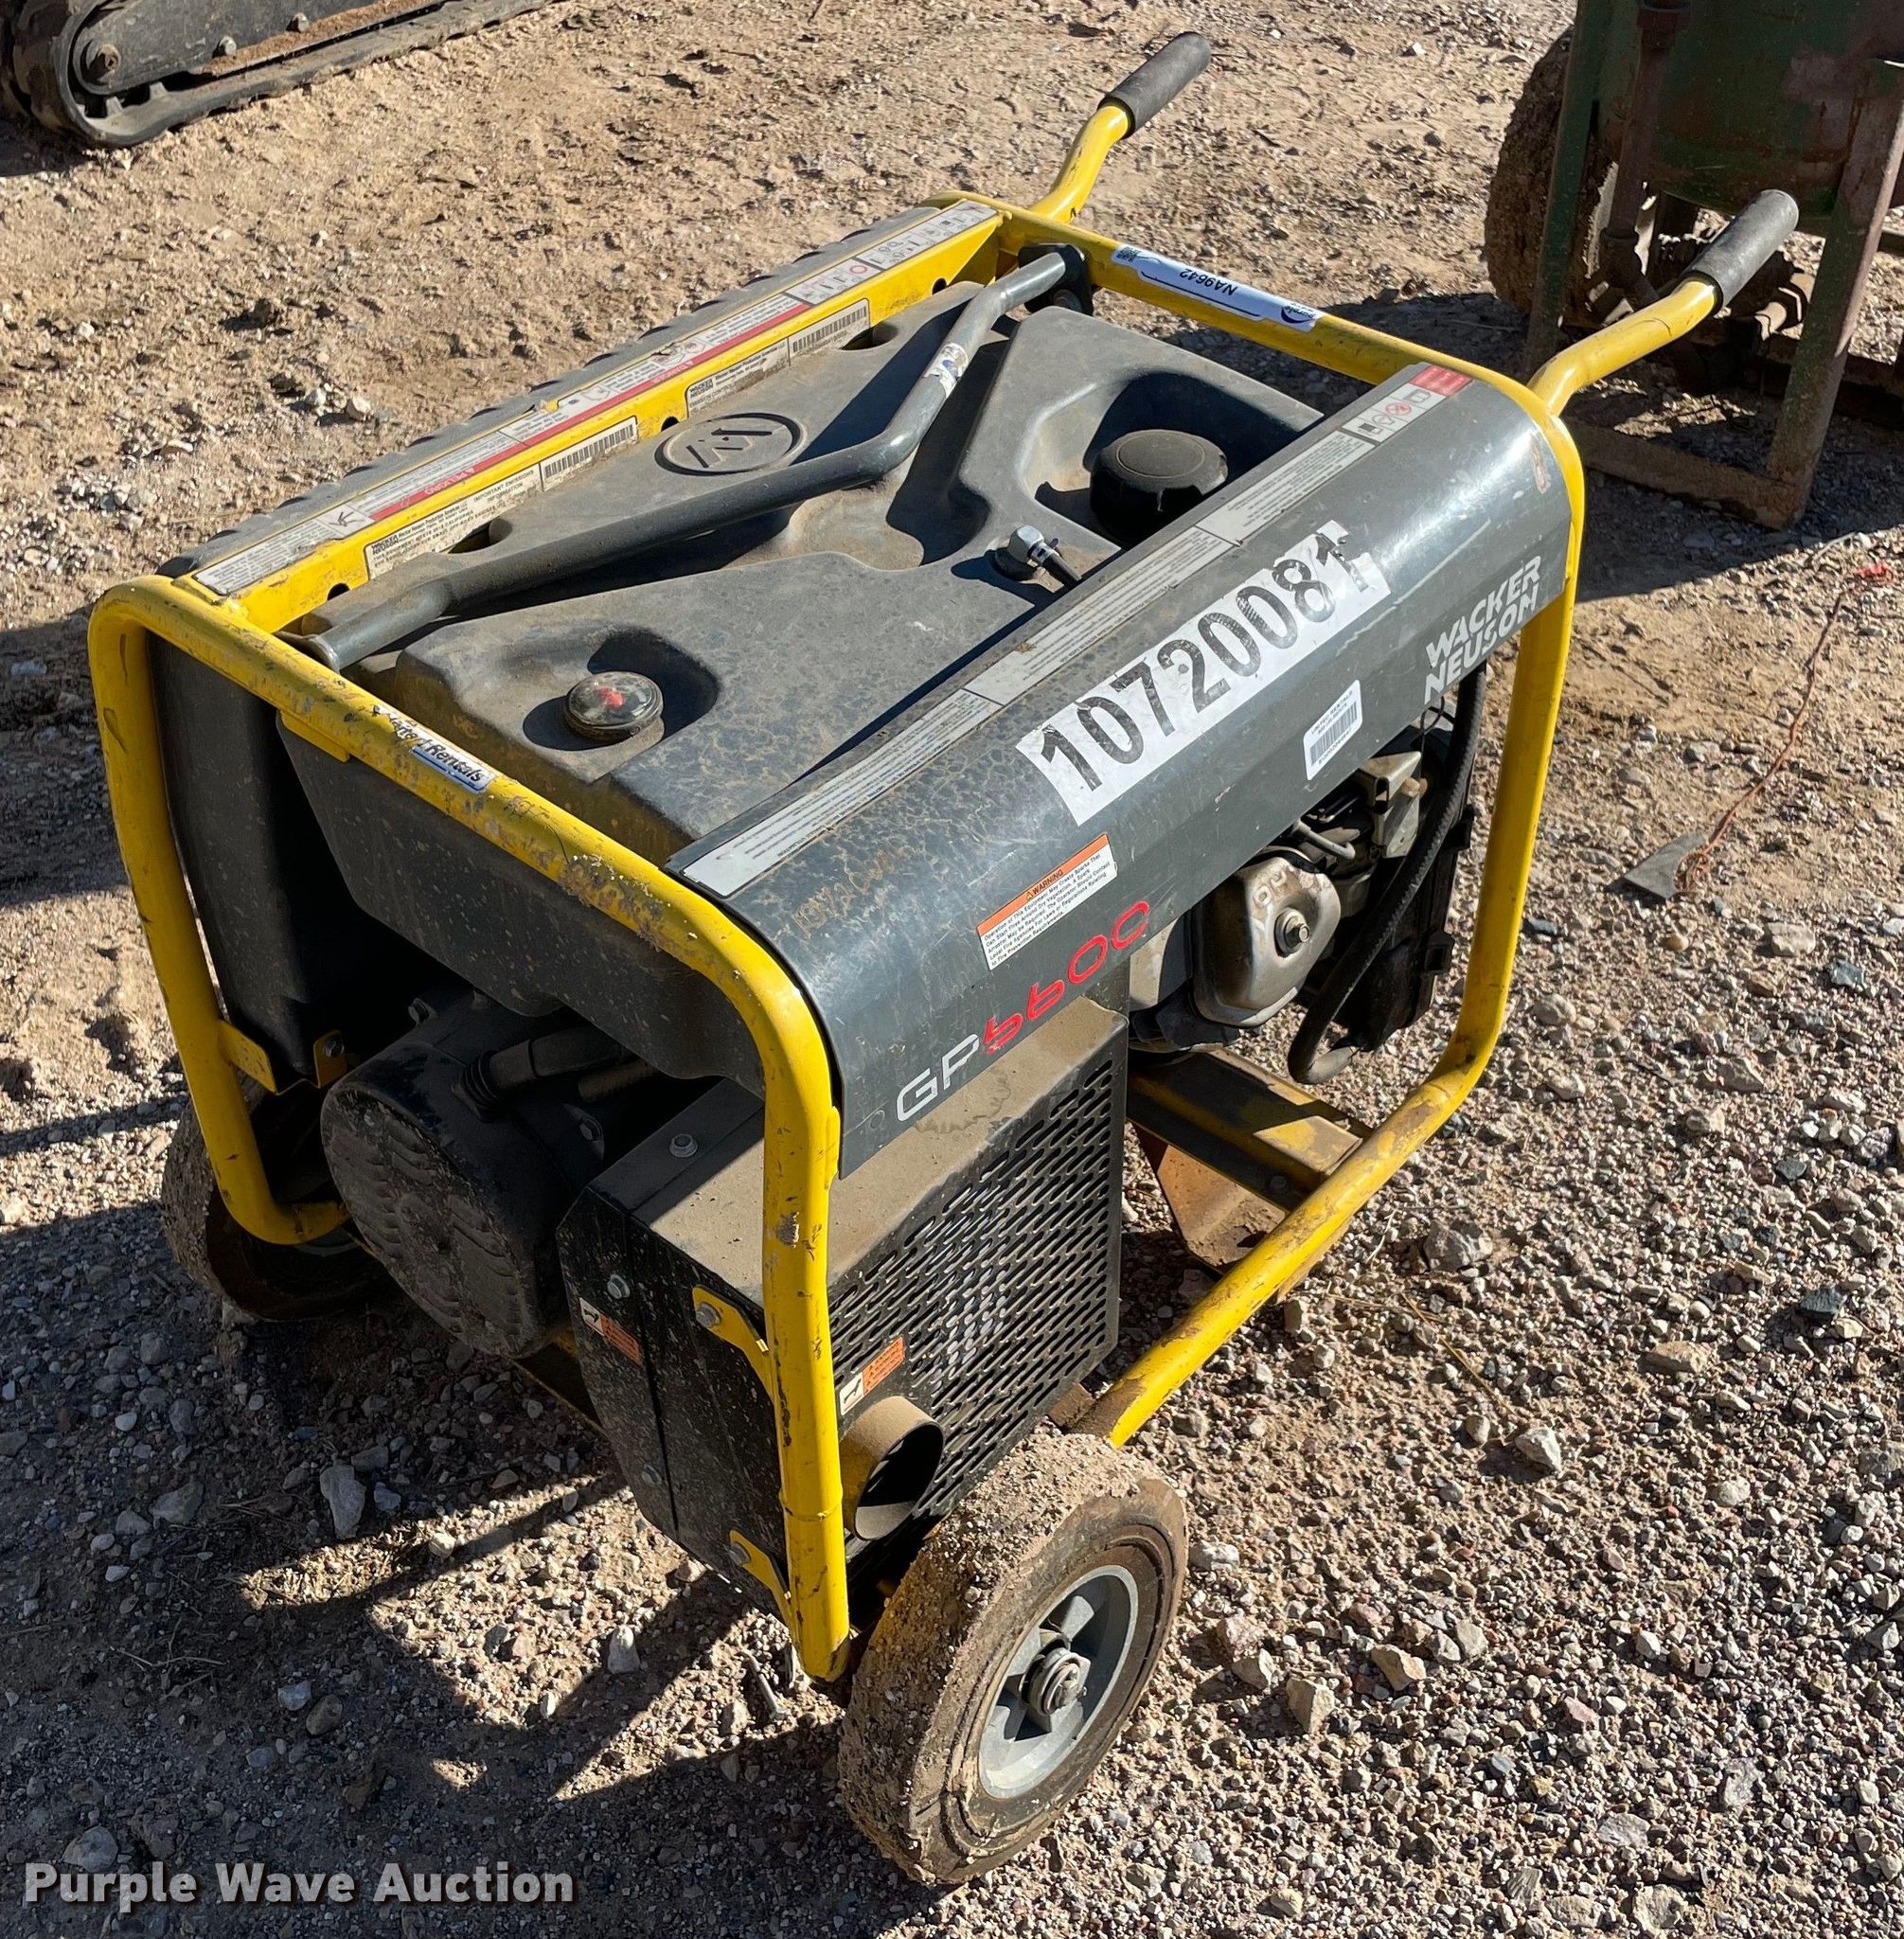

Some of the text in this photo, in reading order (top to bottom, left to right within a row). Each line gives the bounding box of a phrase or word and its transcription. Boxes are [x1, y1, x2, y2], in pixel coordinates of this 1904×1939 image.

[1179, 268, 1237, 296] NA9642
[1424, 582, 1539, 704] NEUSON
[1425, 555, 1541, 668] WACKER
[1040, 532, 1369, 792] 10720081
[426, 744, 485, 782] Rentals
[984, 921, 1006, 941] Operation
[1013, 909, 1023, 919] This
[1023, 891, 1048, 912] Equipment
[1048, 883, 1059, 894] May
[1059, 872, 1074, 886] Create
[1090, 852, 1100, 863] That
[1032, 867, 1063, 896] WARNING
[1047, 899, 1056, 910] The
